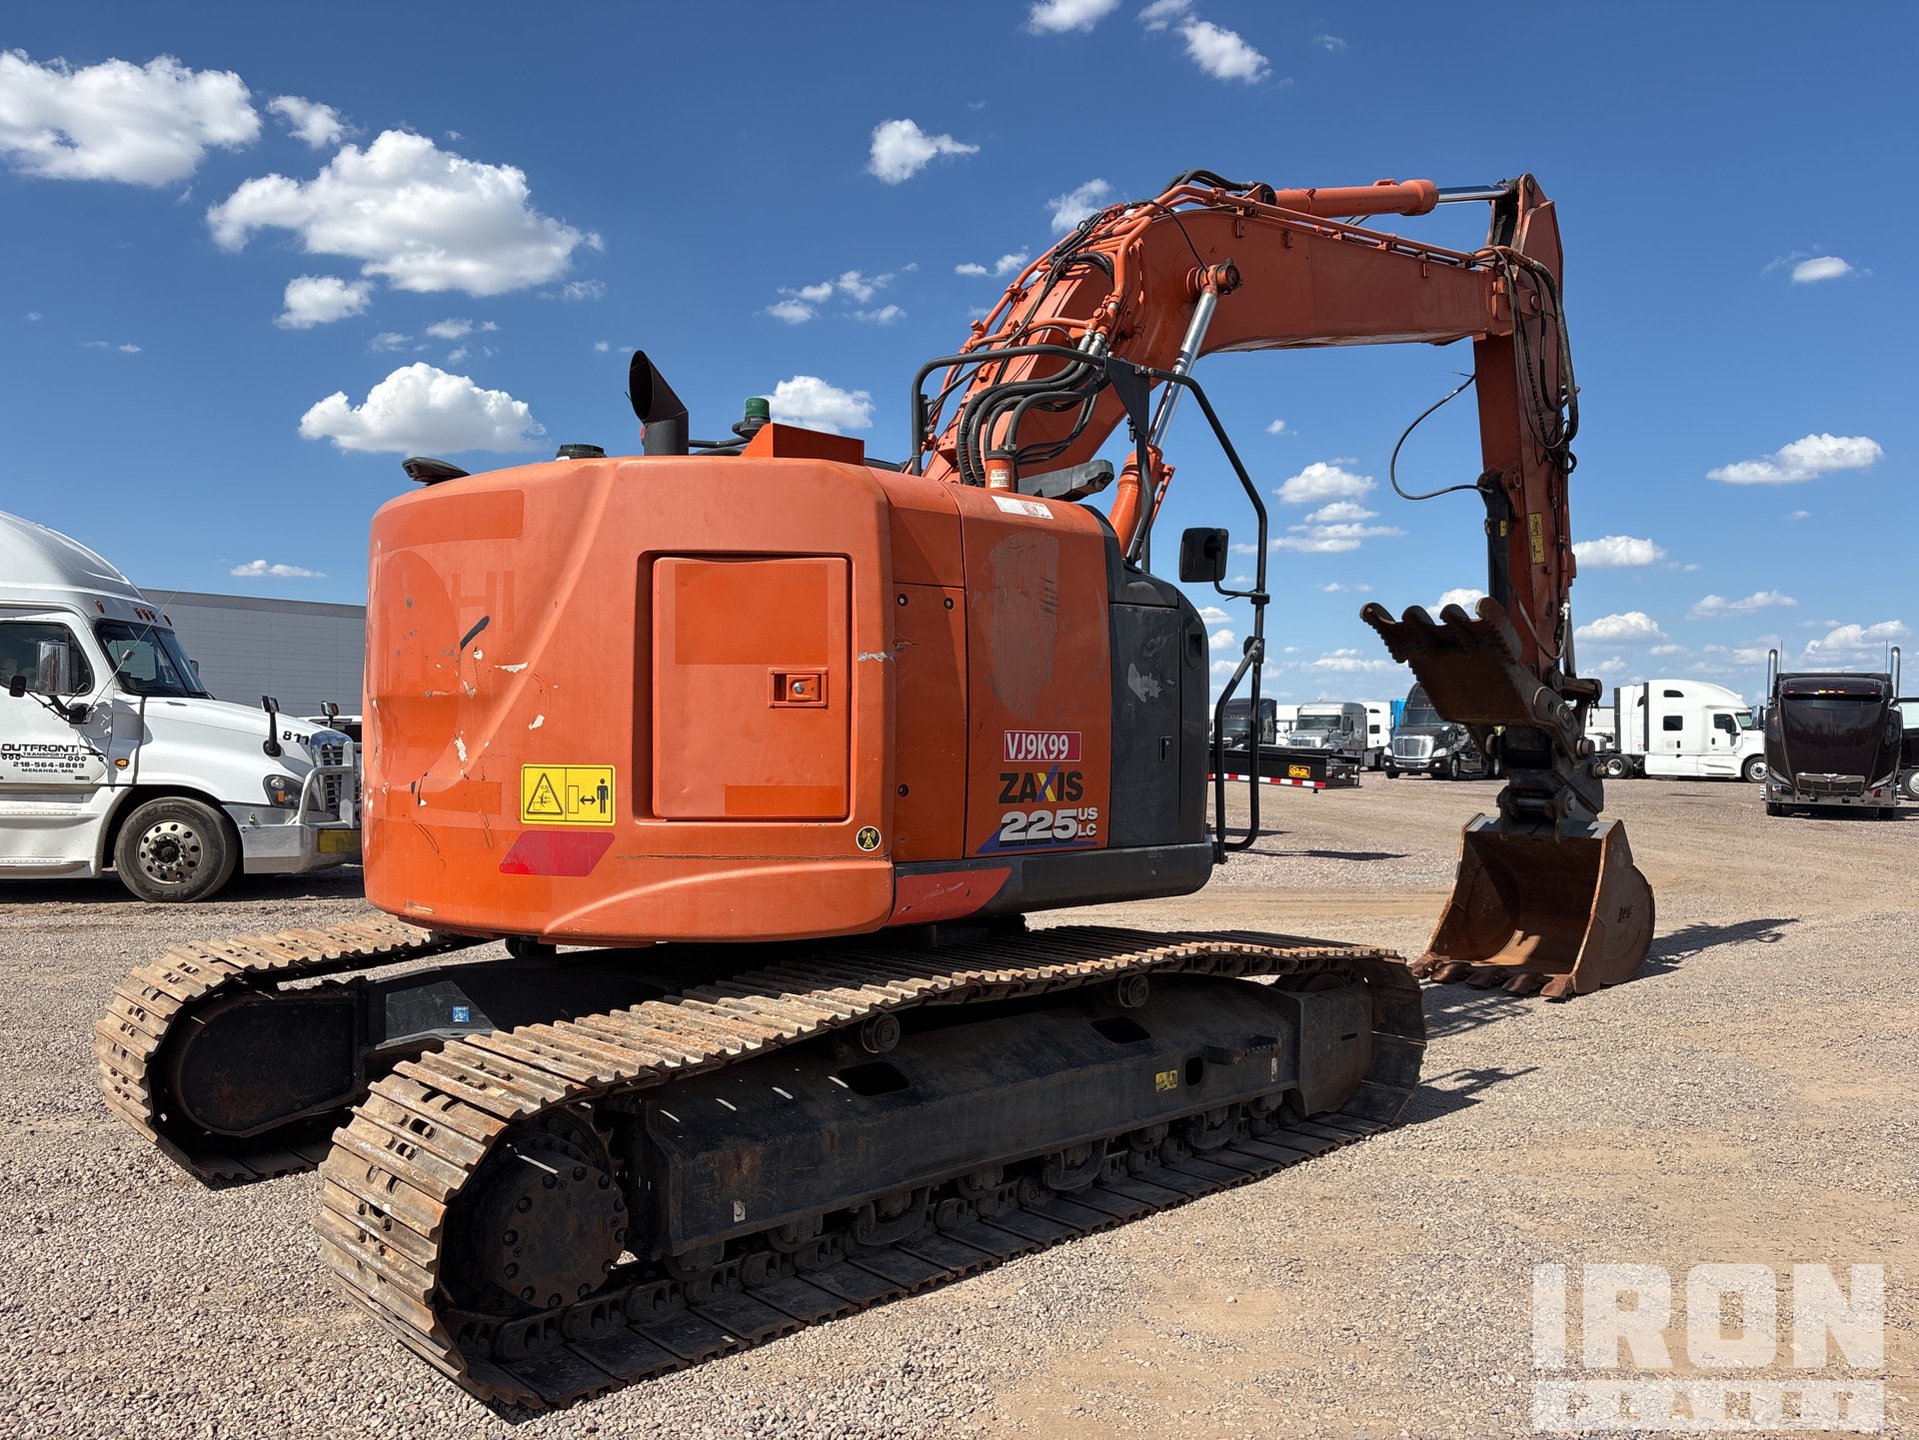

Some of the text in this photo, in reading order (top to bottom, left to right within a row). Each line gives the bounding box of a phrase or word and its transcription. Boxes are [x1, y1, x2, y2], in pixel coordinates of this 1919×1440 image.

[2, 743, 78, 753] OUTFRONT
[283, 731, 309, 745] 811
[1006, 733, 1069, 760] VJ9K99
[999, 764, 1083, 804] ZAXIS
[999, 807, 1099, 845] 225 US
[1078, 823, 1098, 838] LC
